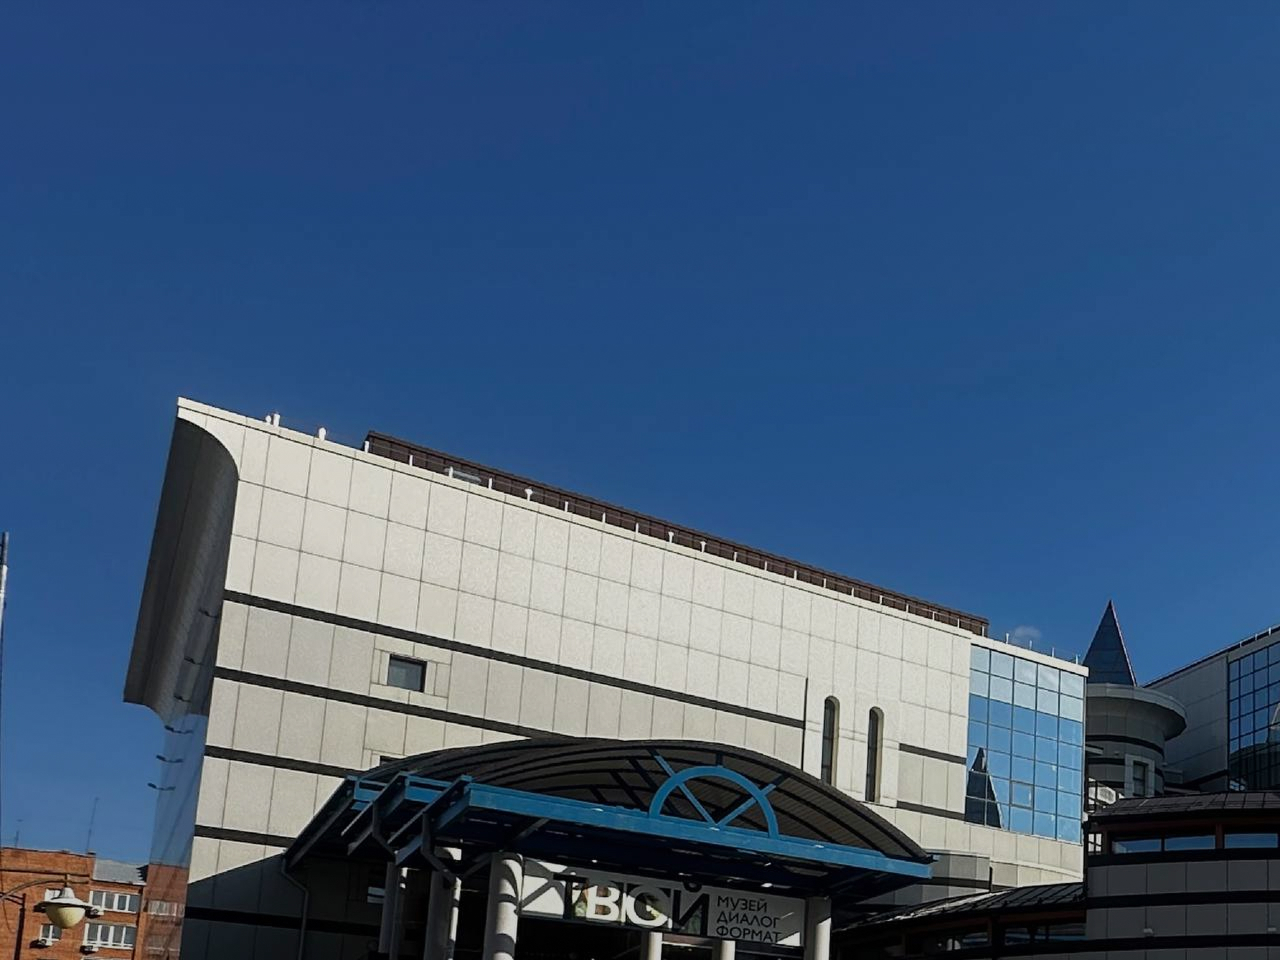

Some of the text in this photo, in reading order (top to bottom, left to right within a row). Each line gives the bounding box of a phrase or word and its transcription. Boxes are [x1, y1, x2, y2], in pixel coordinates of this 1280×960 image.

[716, 895, 768, 913] МУЗЕЙ
[716, 911, 781, 928] ДИАЛОГ
[716, 924, 782, 943] ФОРМАТ
